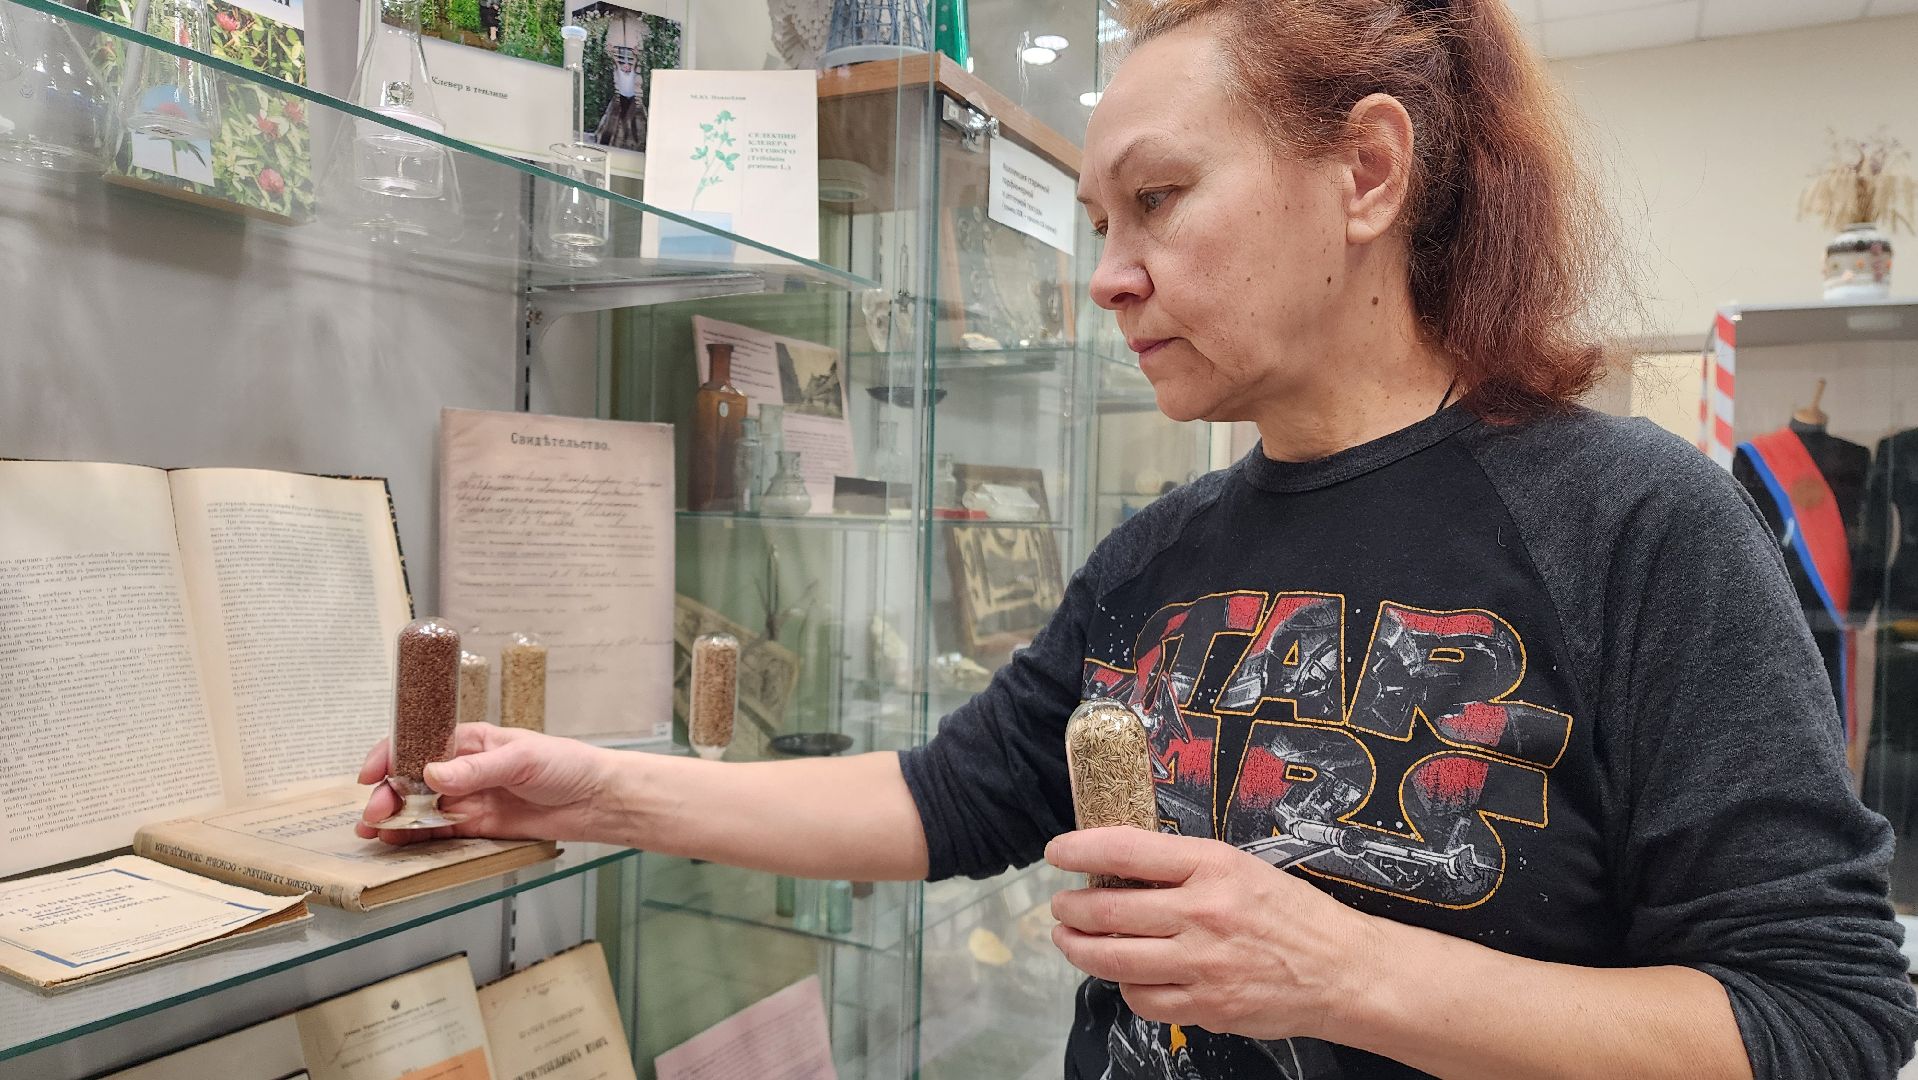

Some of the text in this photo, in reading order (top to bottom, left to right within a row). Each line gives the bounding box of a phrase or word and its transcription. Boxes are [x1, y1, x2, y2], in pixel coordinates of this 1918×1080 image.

[431, 76, 463, 91] Клевер
[474, 87, 508, 99] теплице
[205, 857, 237, 872] ОСНОВЫ
